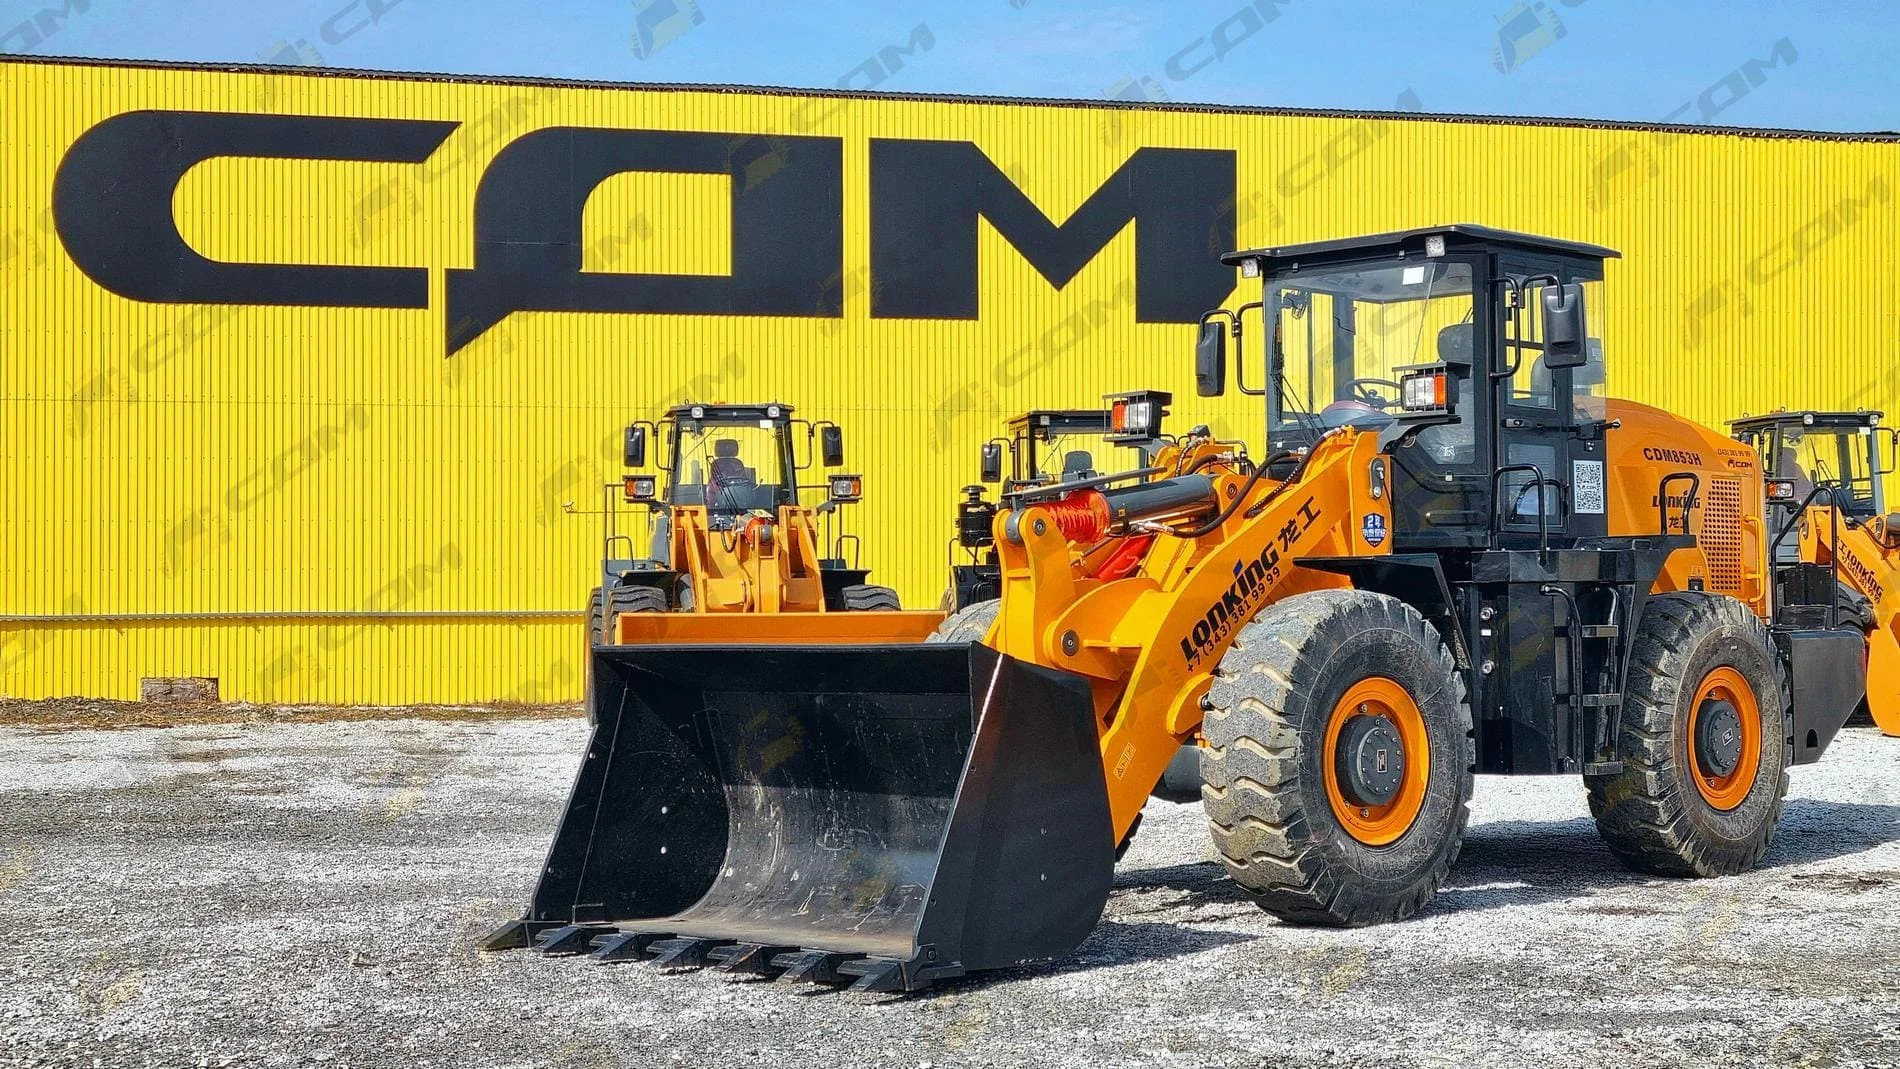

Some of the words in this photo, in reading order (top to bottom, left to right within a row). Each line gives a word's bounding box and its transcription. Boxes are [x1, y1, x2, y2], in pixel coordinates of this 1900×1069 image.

[1643, 447, 1702, 466] CDM853H
[1277, 496, 1322, 552] 龙工
[1201, 617, 1232, 657] (343)
[1231, 599, 1251, 624] 381
[1251, 584, 1266, 602] 99
[1266, 566, 1281, 586] 99
